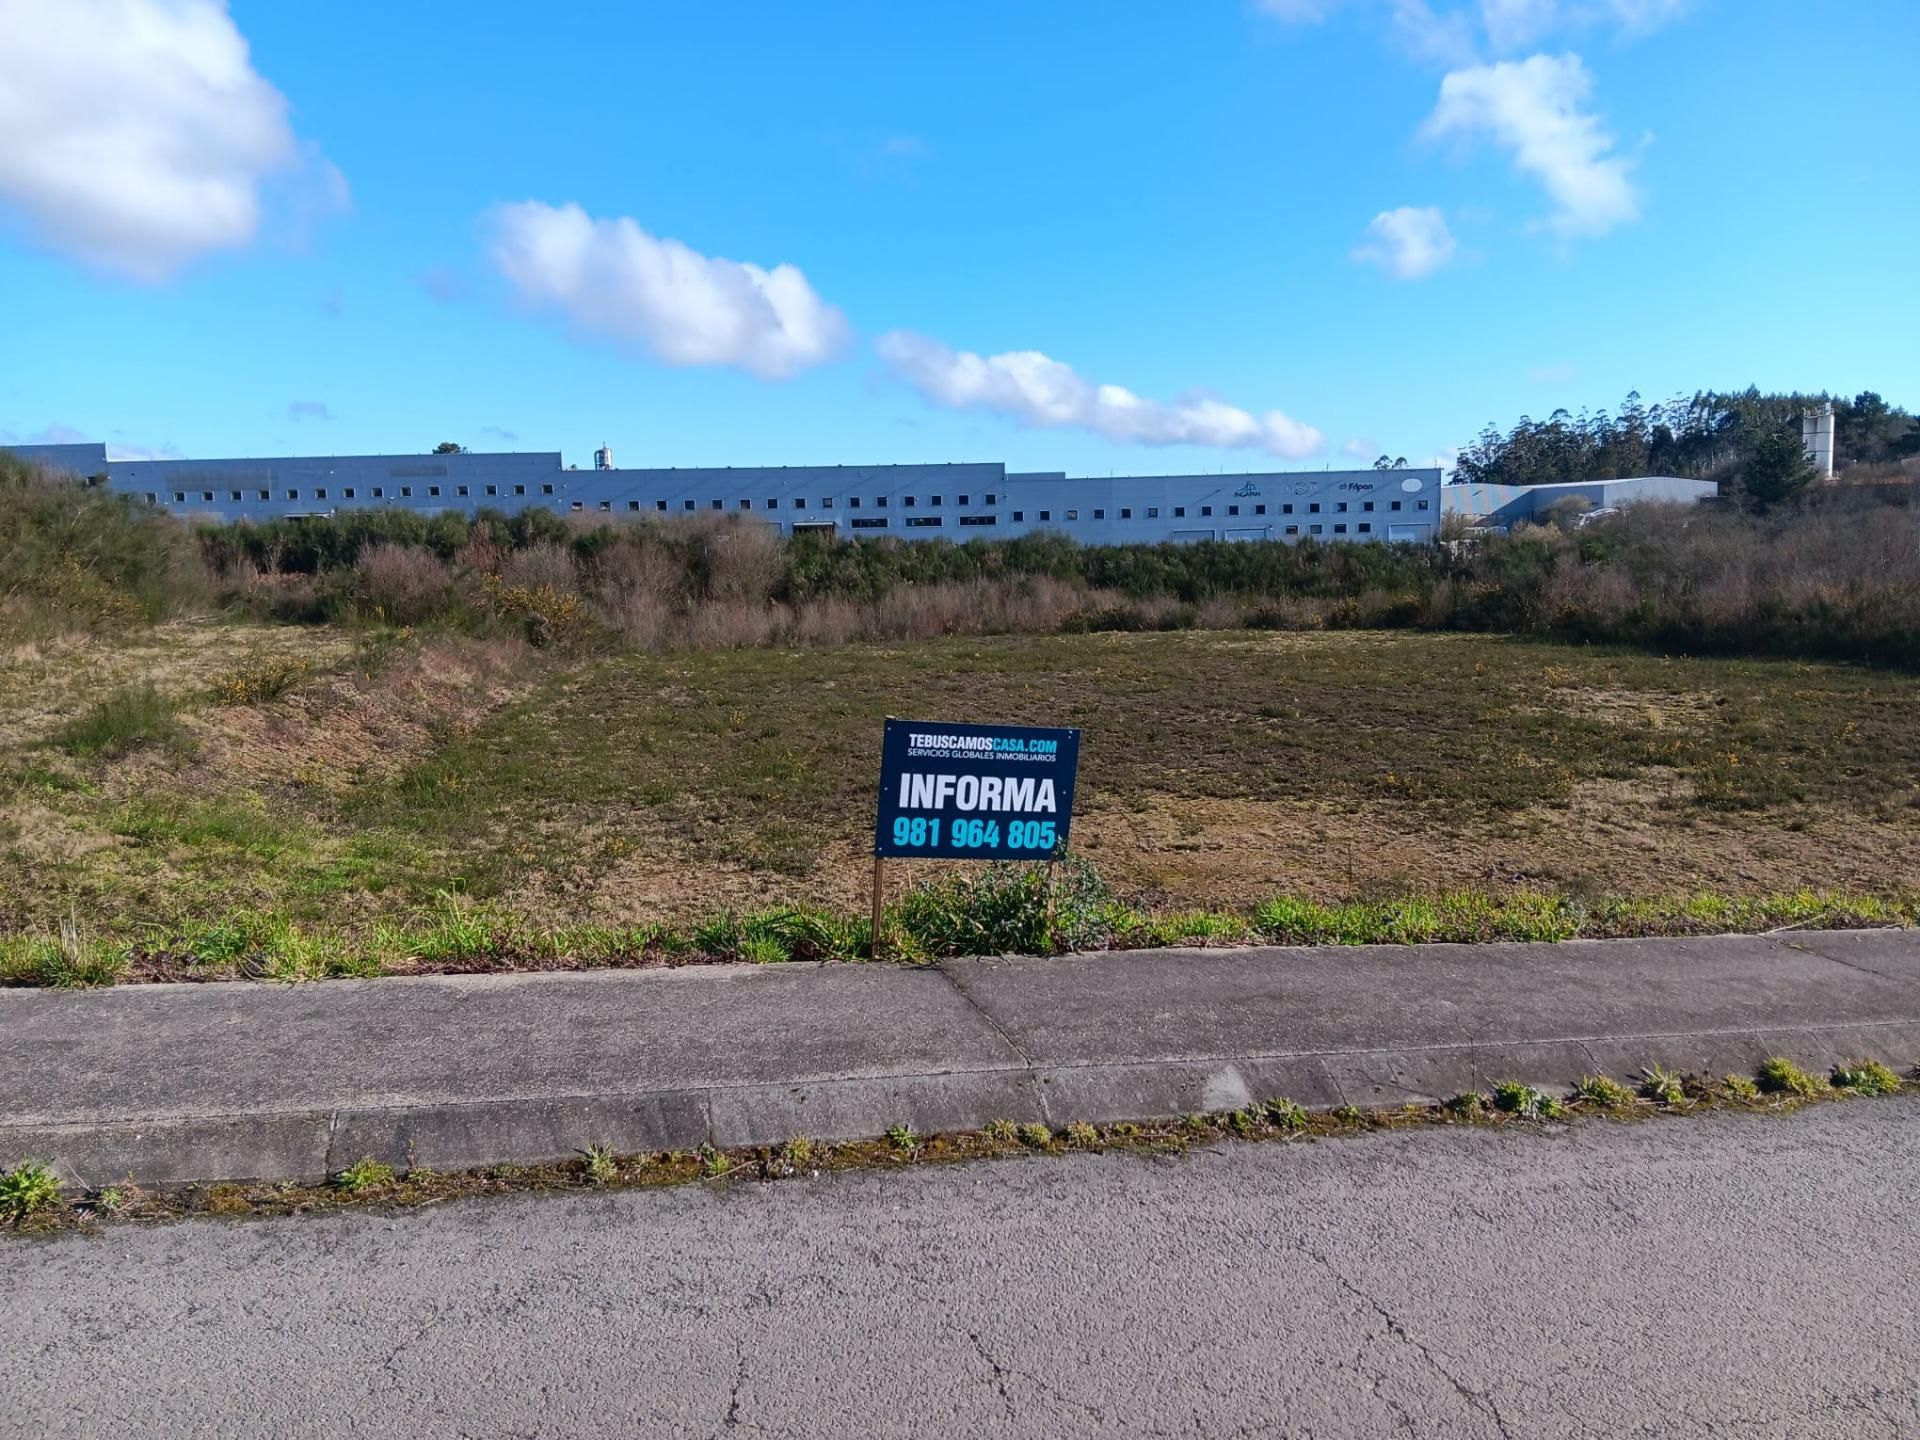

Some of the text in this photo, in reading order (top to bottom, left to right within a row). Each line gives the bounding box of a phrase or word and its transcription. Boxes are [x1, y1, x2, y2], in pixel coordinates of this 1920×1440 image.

[907, 748, 1056, 762] SERVICIOS GLOBALES INMOBILIARIOS
[909, 734, 1057, 753] TEBUSCAMOSCASA.COM
[899, 773, 1056, 812] INFORMA
[893, 817, 1056, 849] 981 964 805
